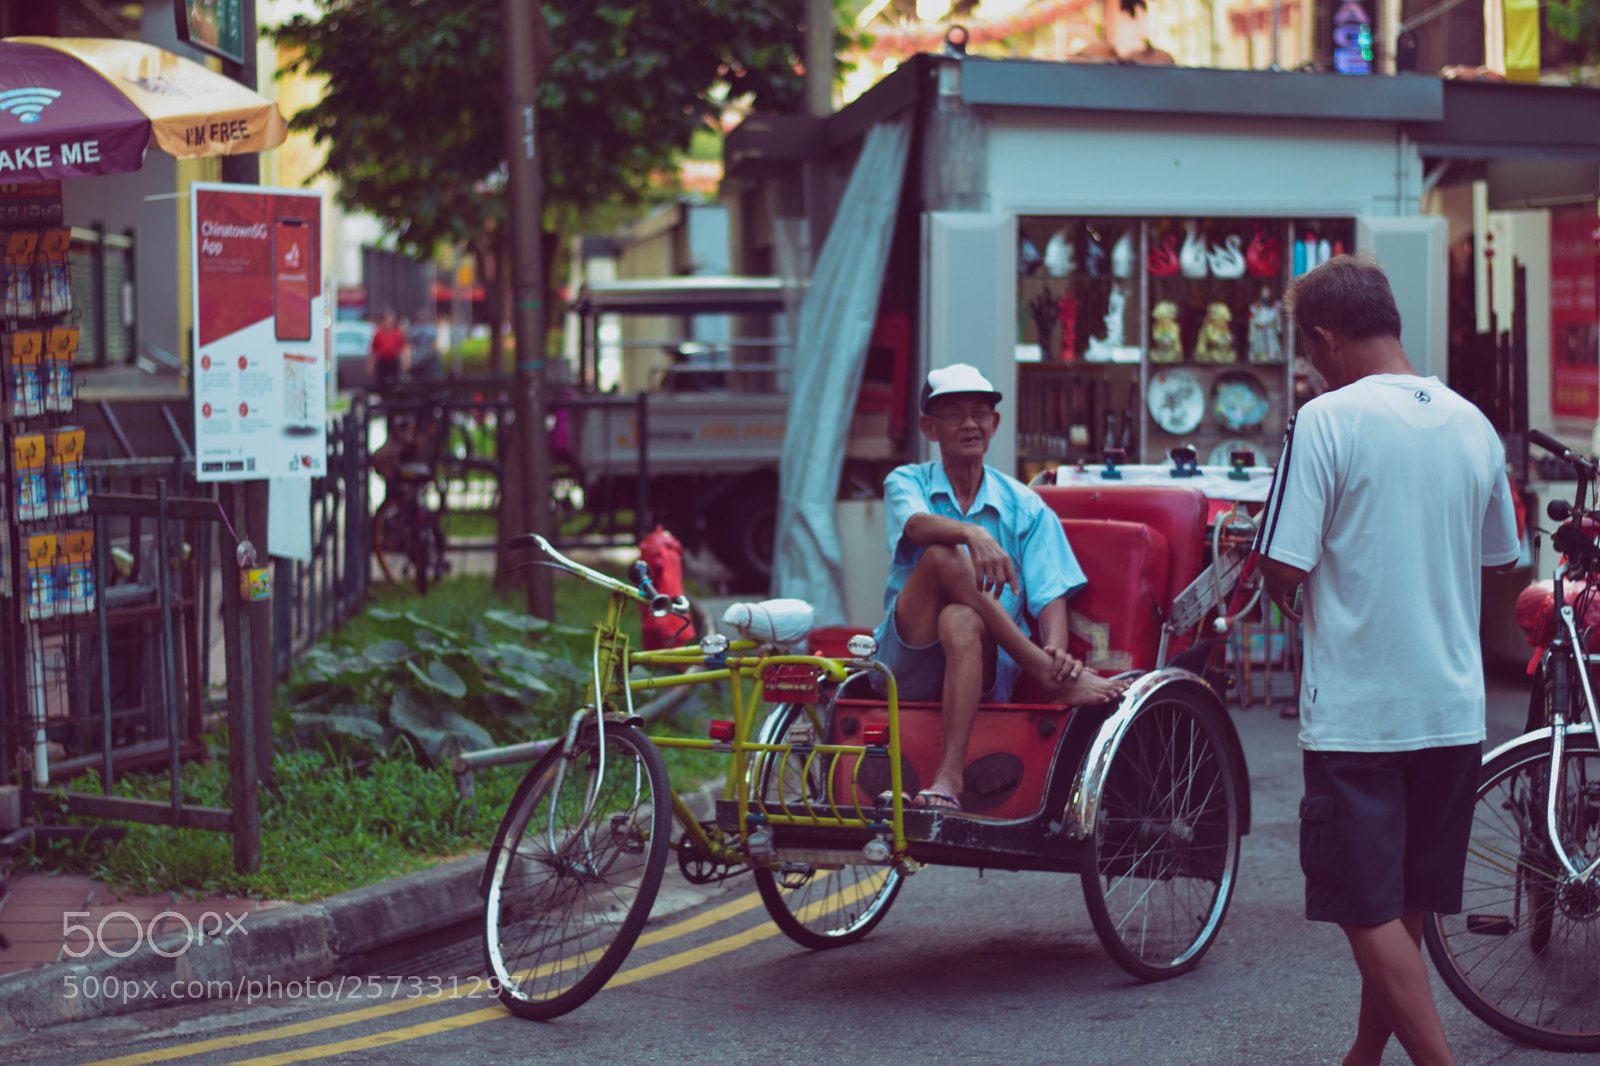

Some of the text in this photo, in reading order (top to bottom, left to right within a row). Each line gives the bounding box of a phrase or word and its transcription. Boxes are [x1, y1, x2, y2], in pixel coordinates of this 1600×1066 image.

[185, 120, 251, 147] I'M FREE
[60, 140, 101, 166] ME
[201, 220, 268, 239] ChinatownSG
[201, 238, 223, 256] App
